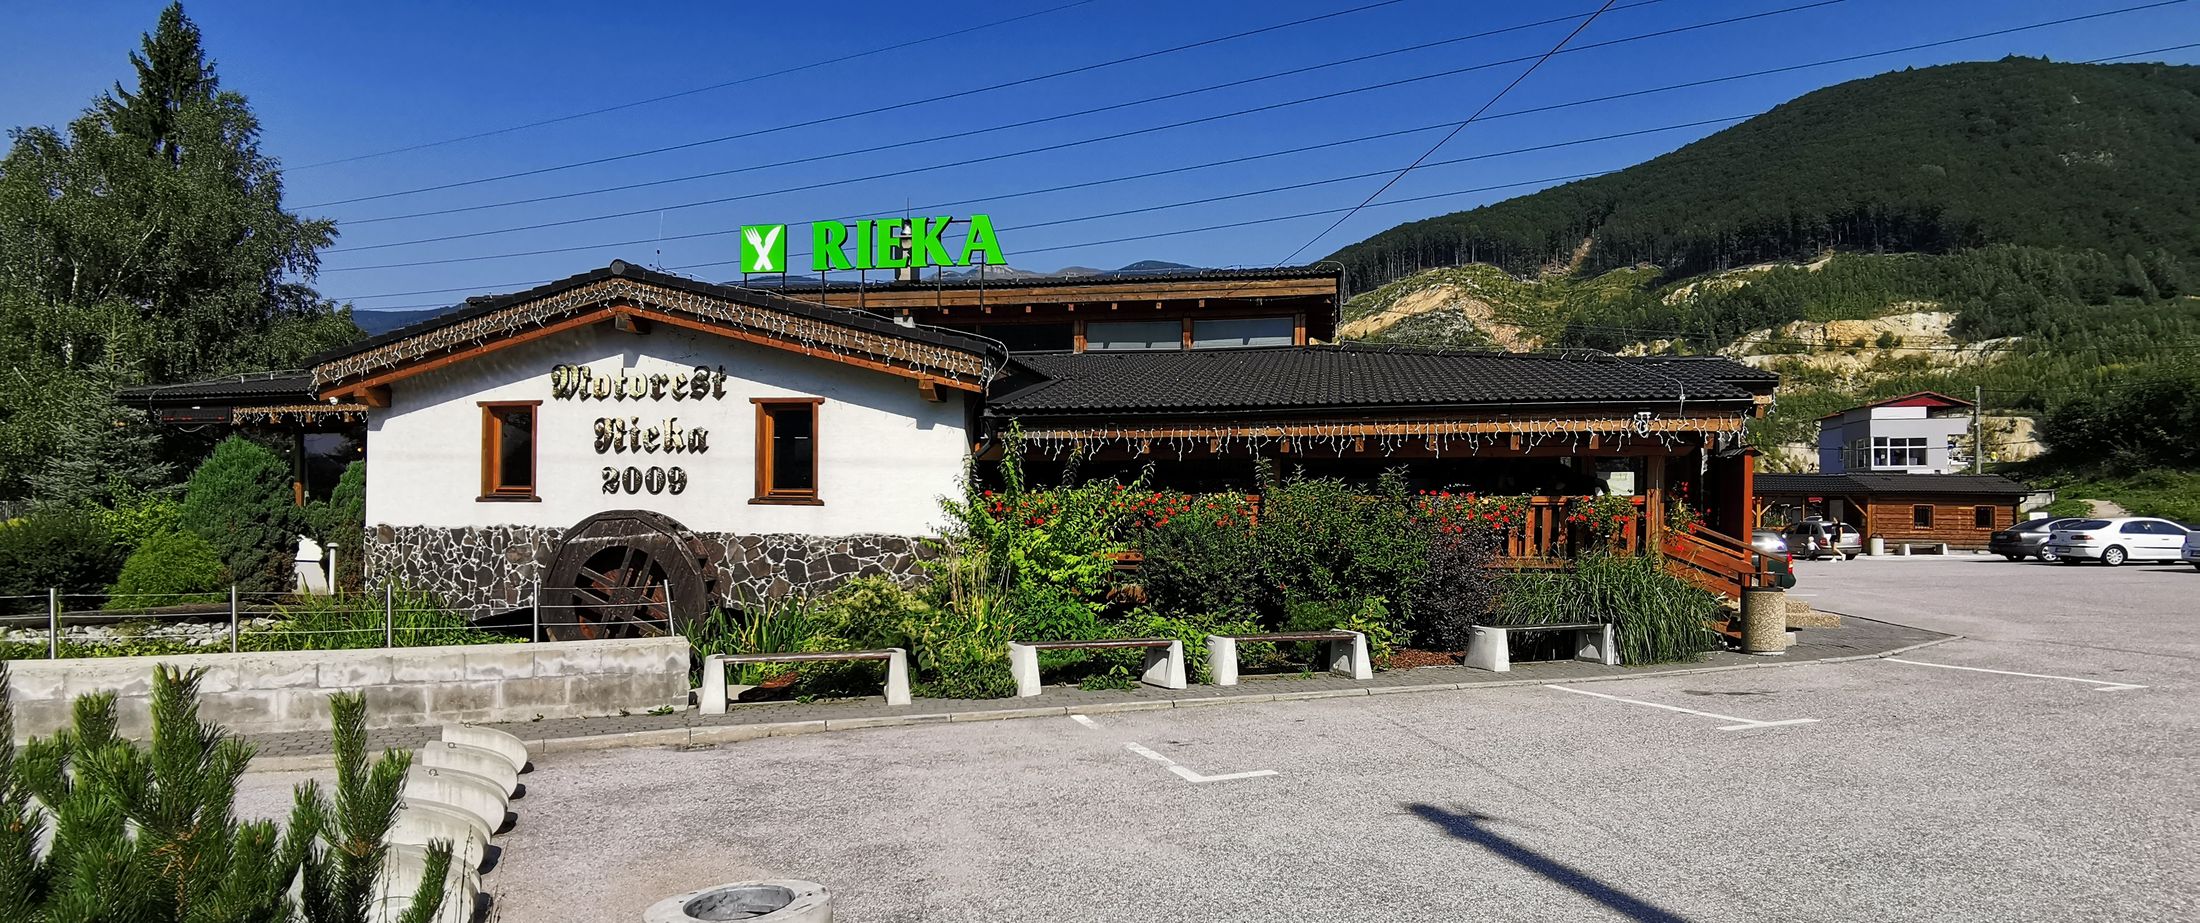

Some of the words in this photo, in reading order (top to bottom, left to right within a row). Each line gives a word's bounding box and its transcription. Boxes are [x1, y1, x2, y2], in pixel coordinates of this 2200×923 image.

[812, 214, 1008, 271] RIEKA
[594, 416, 709, 454] Rieka
[601, 466, 688, 495] 2009
